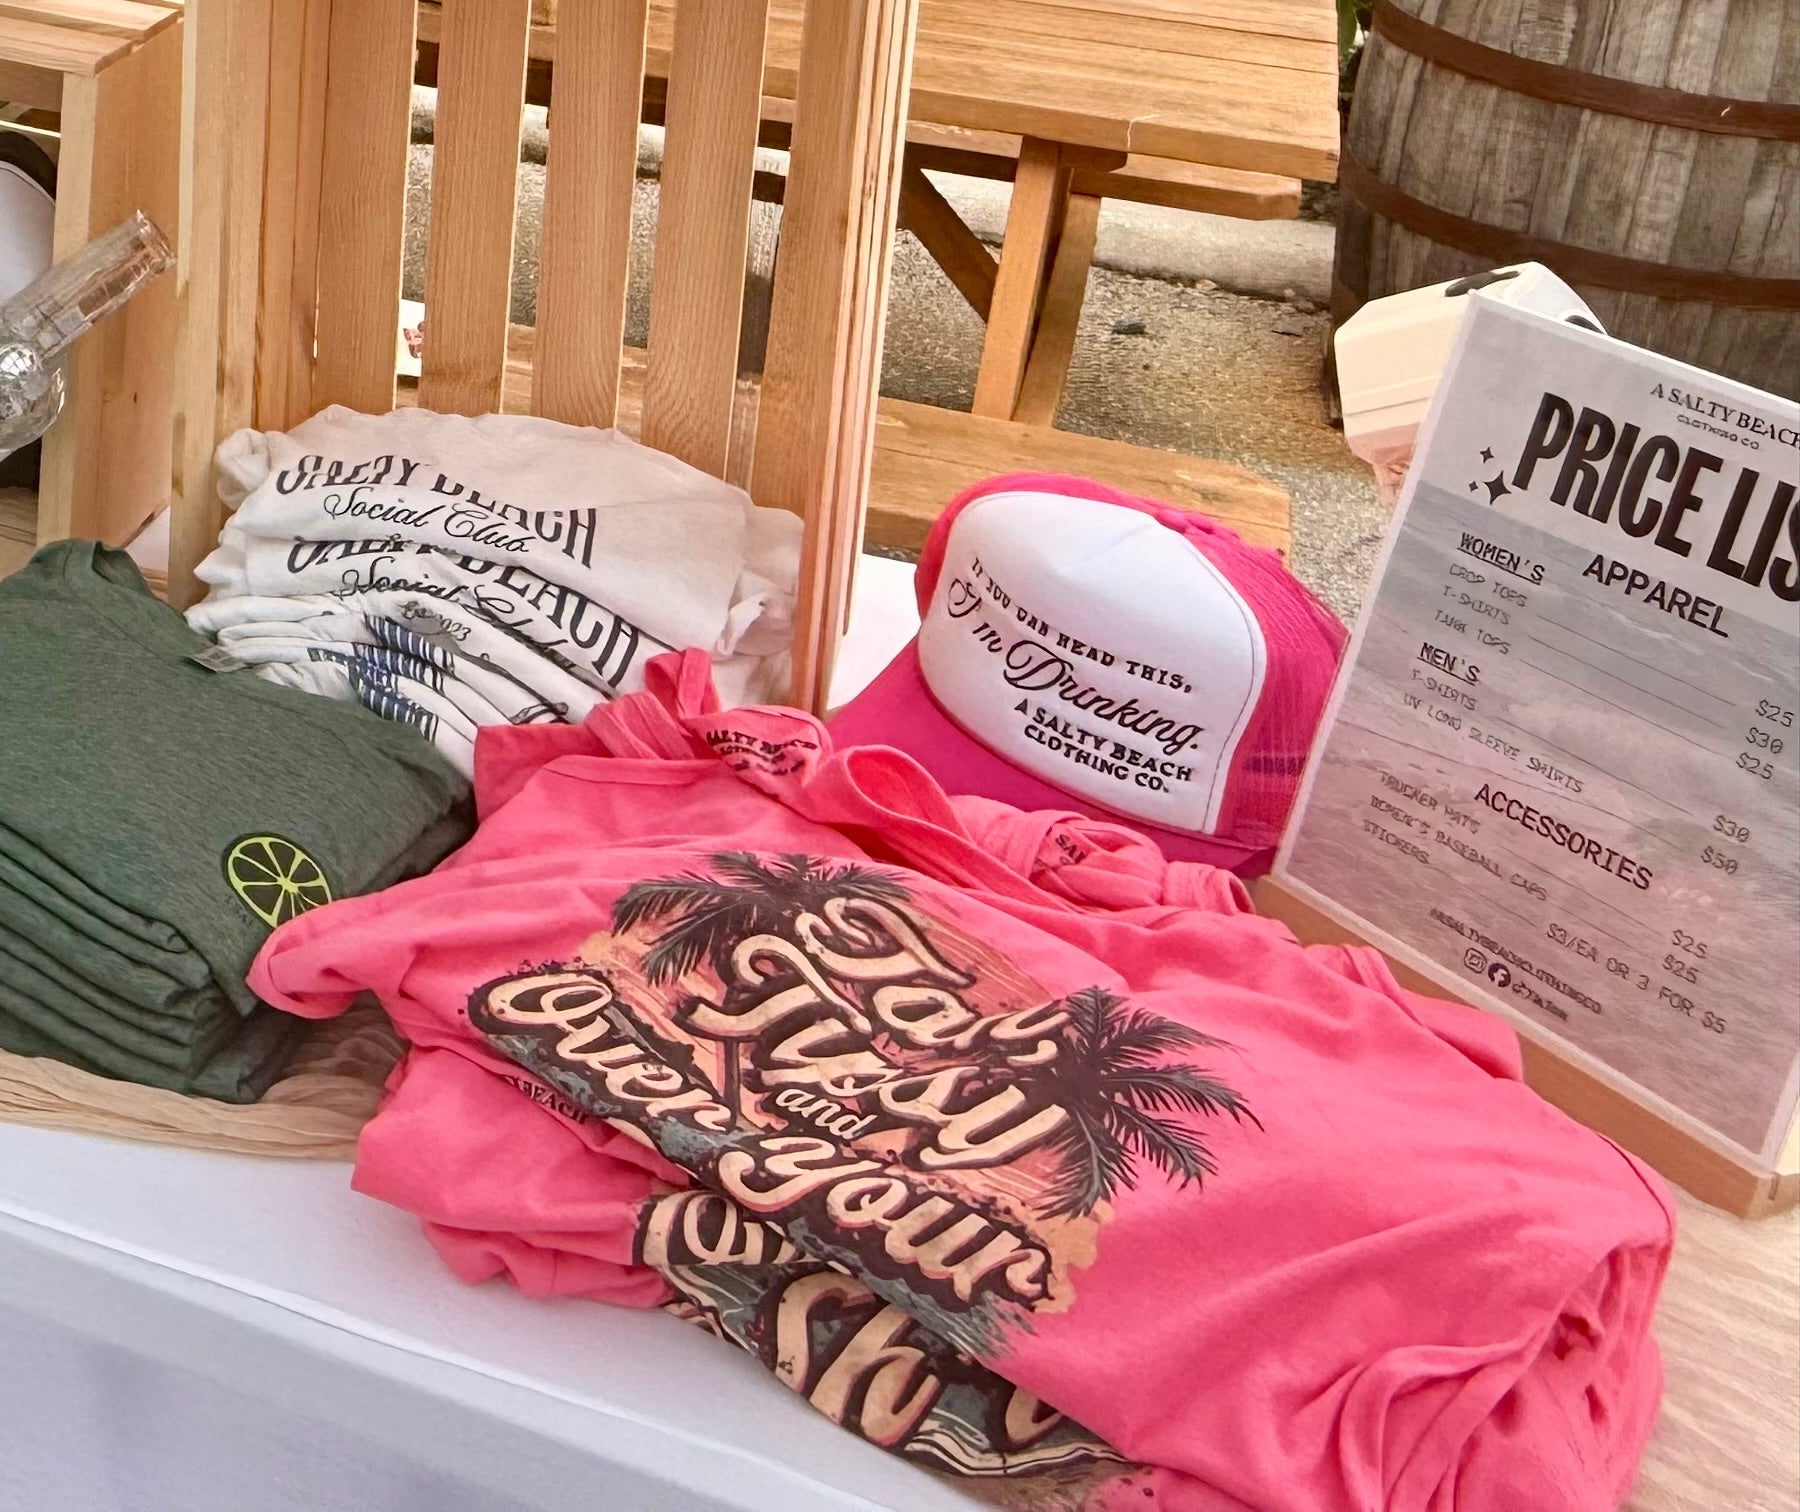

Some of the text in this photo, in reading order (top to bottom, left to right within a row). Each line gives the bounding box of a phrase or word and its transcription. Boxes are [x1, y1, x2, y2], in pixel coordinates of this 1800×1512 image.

[1650, 383, 1664, 399] A
[1667, 388, 1737, 423] SALTY
[1511, 392, 1724, 558] PRICE
[323, 486, 538, 554] Social Club
[1458, 532, 1545, 584] WOMEN'S
[1582, 553, 1730, 639] APPAREL
[985, 575, 1012, 609] YOU
[1016, 606, 1051, 638] CAN
[1056, 632, 1115, 668] READ
[1124, 660, 1193, 694] THIS,
[1419, 642, 1481, 684] MEN'S
[1003, 639, 1206, 756] Drinking.
[1754, 699, 1795, 728] $25
[1013, 698, 1193, 783] A SALTY BEACH
[1023, 724, 1171, 794] CLOTHING CO.
[1735, 751, 1774, 780] $25
[1745, 727, 1784, 755] $30
[1474, 783, 1654, 890] ACCESSORIES
[1701, 845, 1738, 875] $50
[1713, 814, 1751, 843] $30
[1662, 954, 1700, 984] $25
[1672, 929, 1708, 959] $25
[795, 896, 1070, 1069] Tan,
[1606, 957, 1630, 980] OR
[1635, 974, 1650, 991] 3
[1658, 986, 1694, 1017] FOR
[1701, 1011, 1727, 1034] $5
[486, 971, 728, 1135] Over
[686, 933, 1070, 1172] Tipsy
[773, 1087, 865, 1141] and
[718, 1135, 1056, 1301] Your
